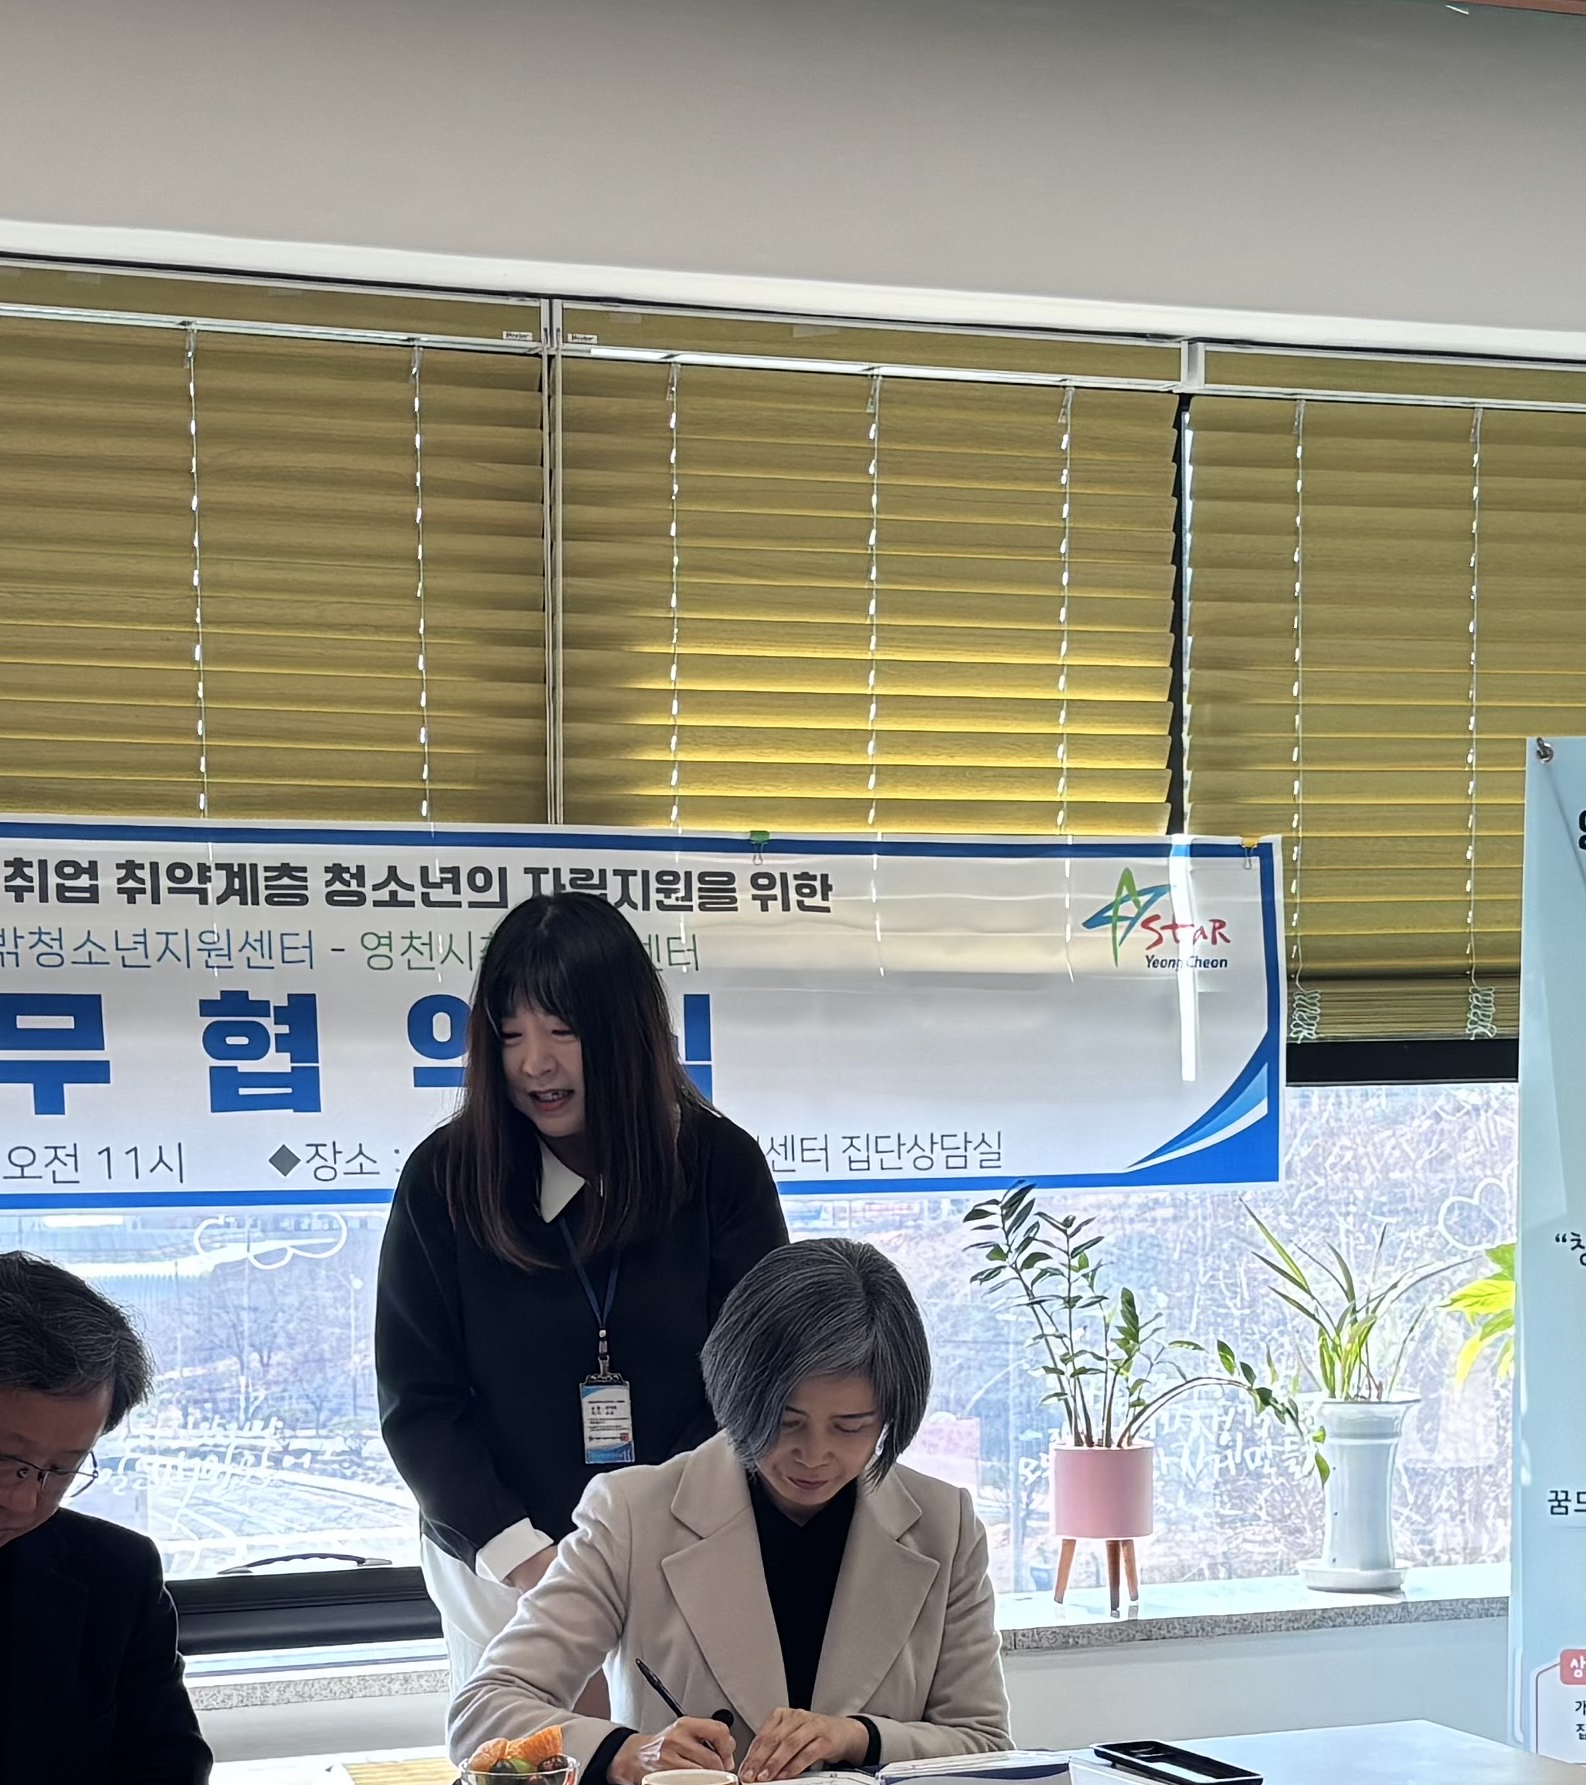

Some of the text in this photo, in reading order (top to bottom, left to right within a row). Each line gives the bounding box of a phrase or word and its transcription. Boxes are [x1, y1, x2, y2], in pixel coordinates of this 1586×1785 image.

[4, 856, 100, 906] 취업
[116, 858, 310, 908] 취약계층
[324, 862, 509, 911] 청소년의
[750, 870, 832, 913] 위한
[3, 1143, 78, 1184] 오전
[97, 1142, 185, 1184] 11시
[305, 1141, 377, 1182] 장소
[841, 1131, 1001, 1171] 집단상담실
